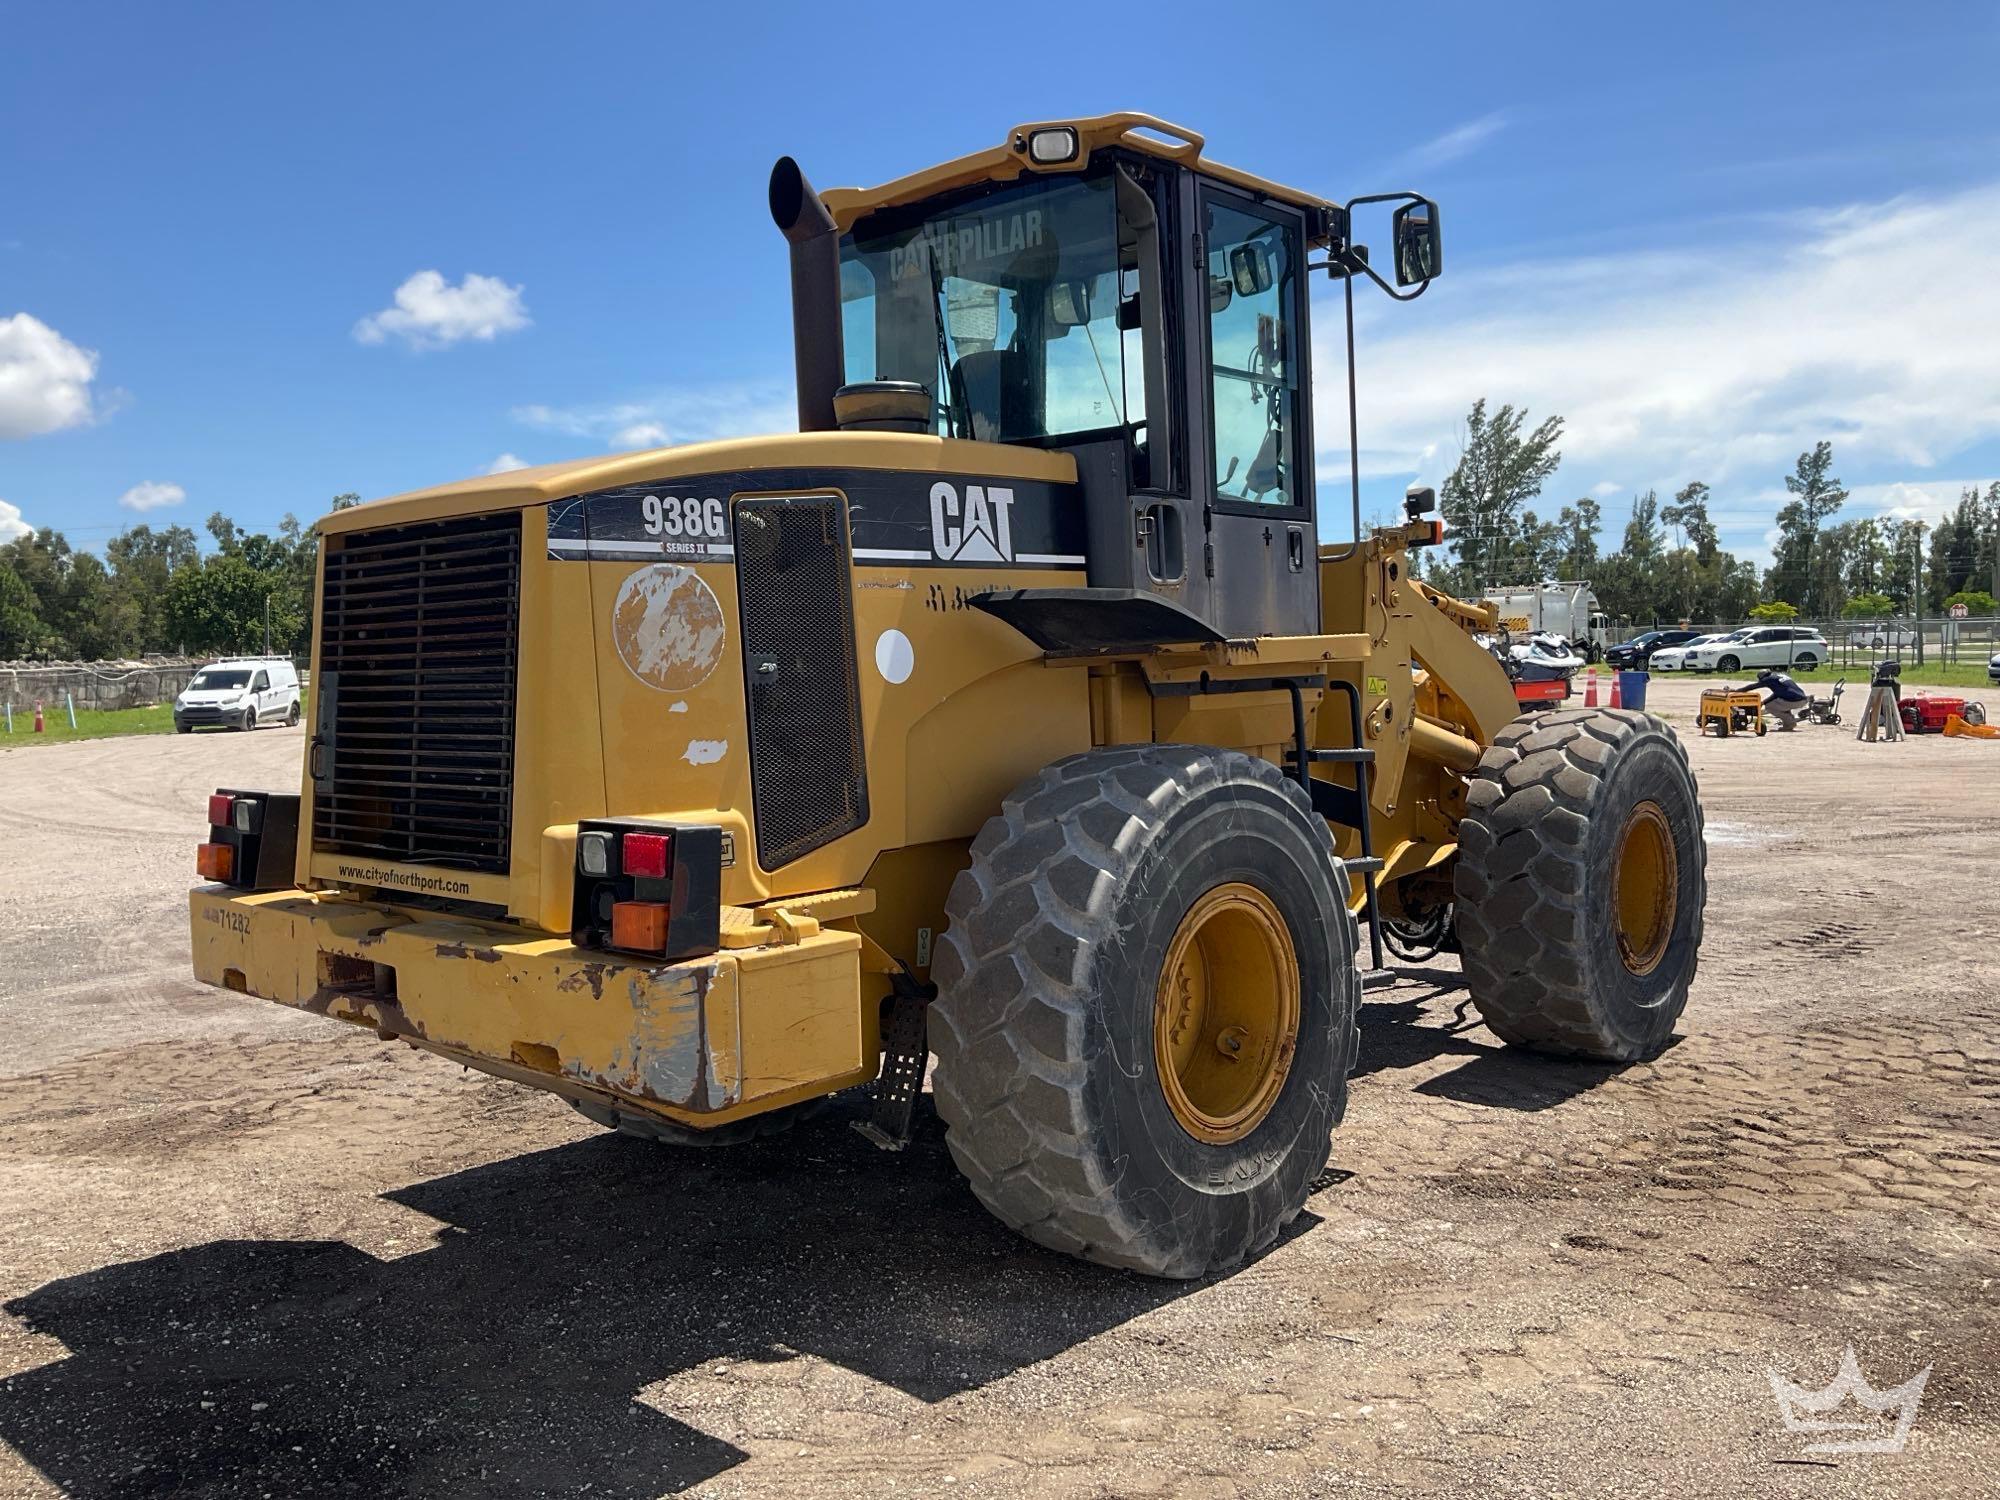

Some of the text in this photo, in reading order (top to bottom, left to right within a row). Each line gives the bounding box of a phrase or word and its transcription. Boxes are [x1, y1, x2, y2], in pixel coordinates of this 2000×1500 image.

[642, 495, 725, 537] 938G
[930, 481, 1014, 562] CAT
[666, 542, 705, 554] SERIES II
[339, 864, 470, 895] www.cityofnorthport.com
[219, 908, 251, 936] 71282
